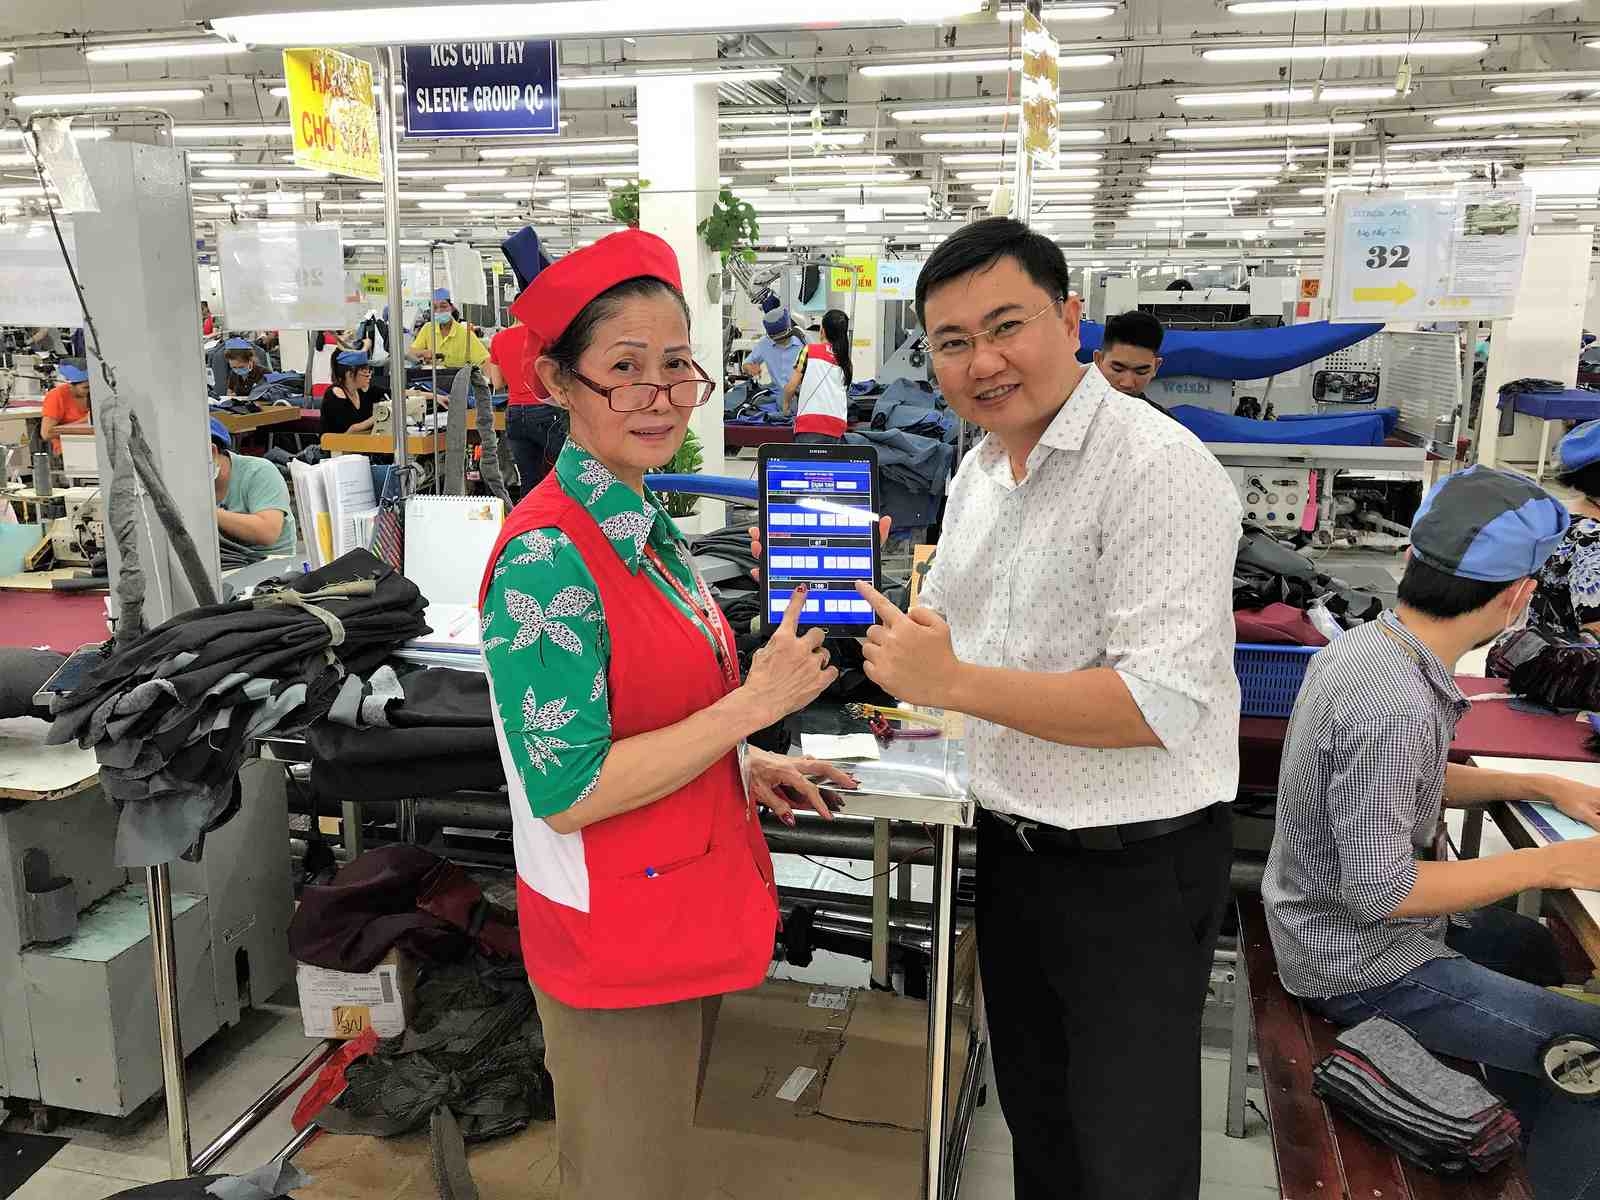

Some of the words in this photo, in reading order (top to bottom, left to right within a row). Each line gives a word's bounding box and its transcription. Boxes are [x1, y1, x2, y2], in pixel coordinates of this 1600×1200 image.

[430, 42, 458, 66] KCS
[498, 40, 525, 64] TAY
[416, 86, 469, 114] SLEEVE
[472, 84, 521, 112] GROUP
[524, 84, 544, 115] QC
[1366, 244, 1410, 269] 32
[882, 276, 900, 284] 100
